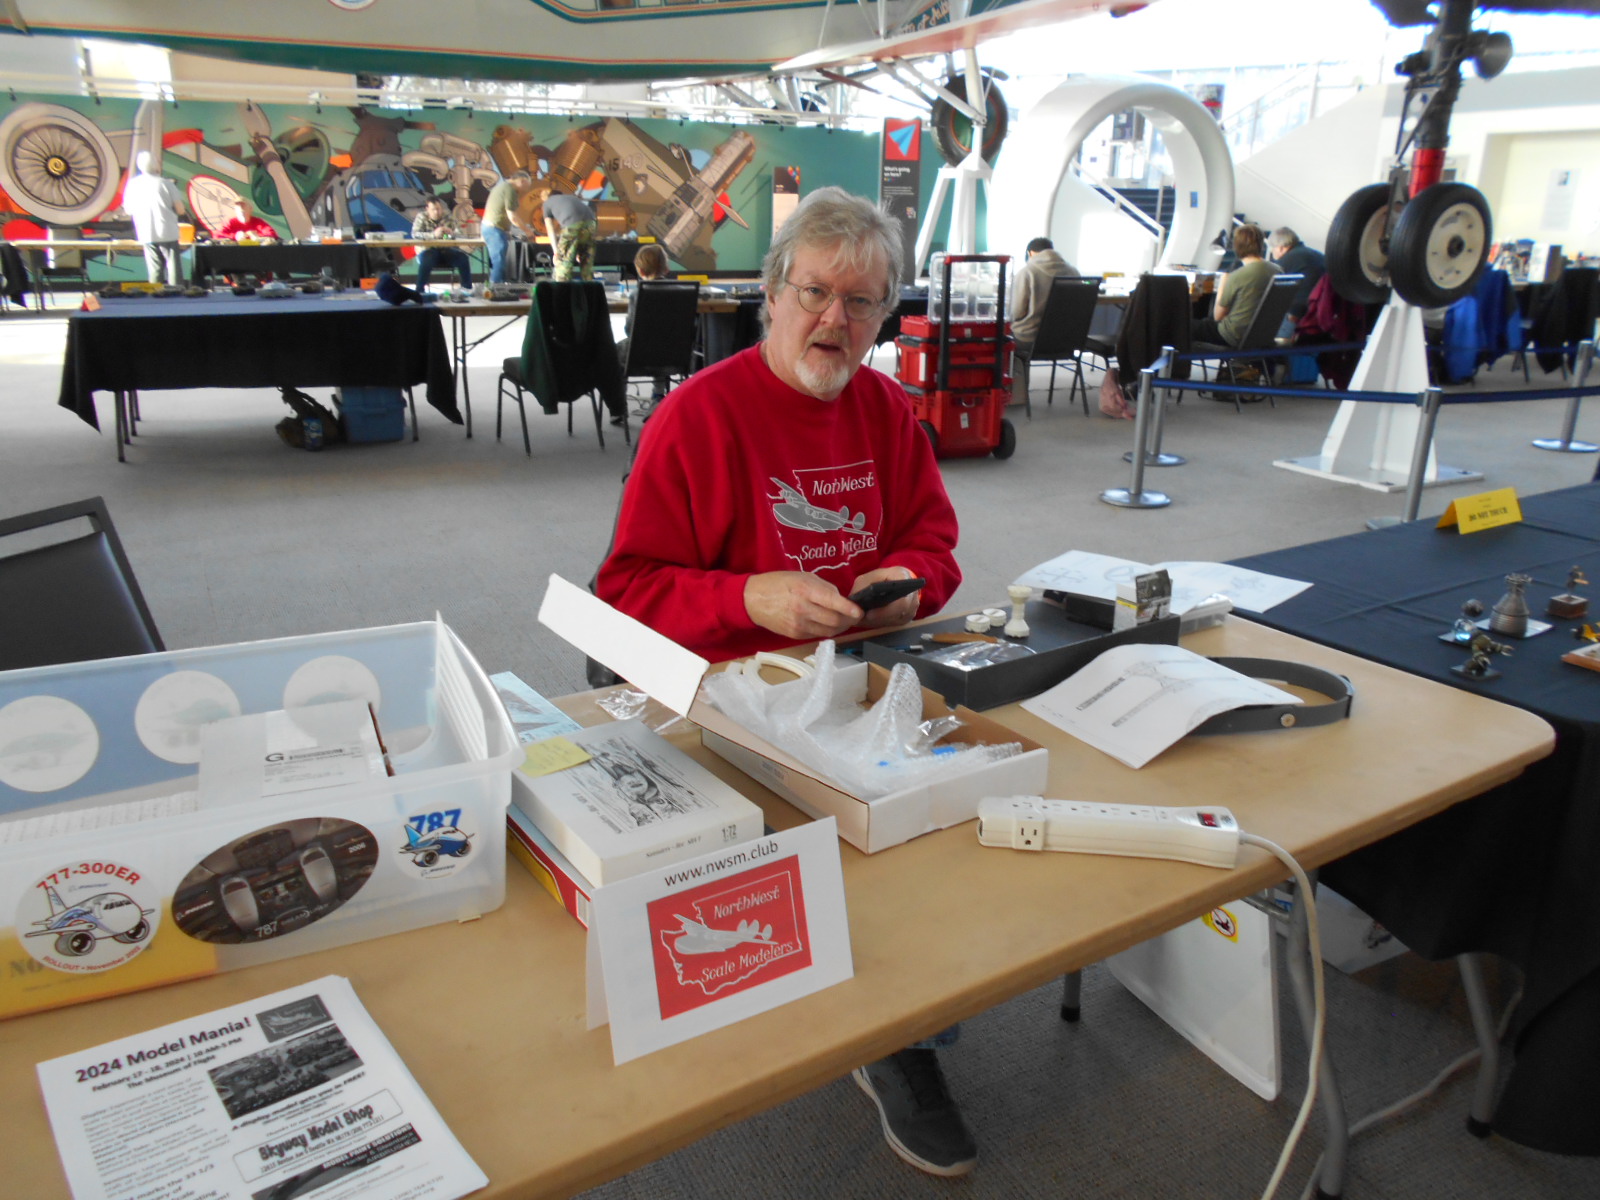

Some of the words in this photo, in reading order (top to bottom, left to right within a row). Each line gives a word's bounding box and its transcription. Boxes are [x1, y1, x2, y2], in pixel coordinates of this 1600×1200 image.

[800, 542, 837, 560] Scale
[408, 808, 462, 833] 787
[36, 862, 141, 889] 777-300ER
[664, 839, 779, 887] www.nwsm.club
[714, 885, 780, 919] NorthWest
[254, 920, 279, 939] 787
[42, 955, 79, 971] ROLLOUT
[701, 958, 736, 983] Scale
[738, 940, 794, 970] Modelers
[75, 1057, 123, 1083] 2024
[126, 1037, 187, 1066] Model
[189, 1017, 251, 1045] Mania!
[92, 1074, 132, 1093] February
[164, 1056, 186, 1069] 2024
[127, 1079, 144, 1090] The
[144, 1066, 182, 1084] Museum
[193, 1054, 216, 1067] Flight
[258, 1133, 309, 1161] Skyway
[307, 1115, 344, 1141] Model
[343, 1104, 374, 1125] Shop
